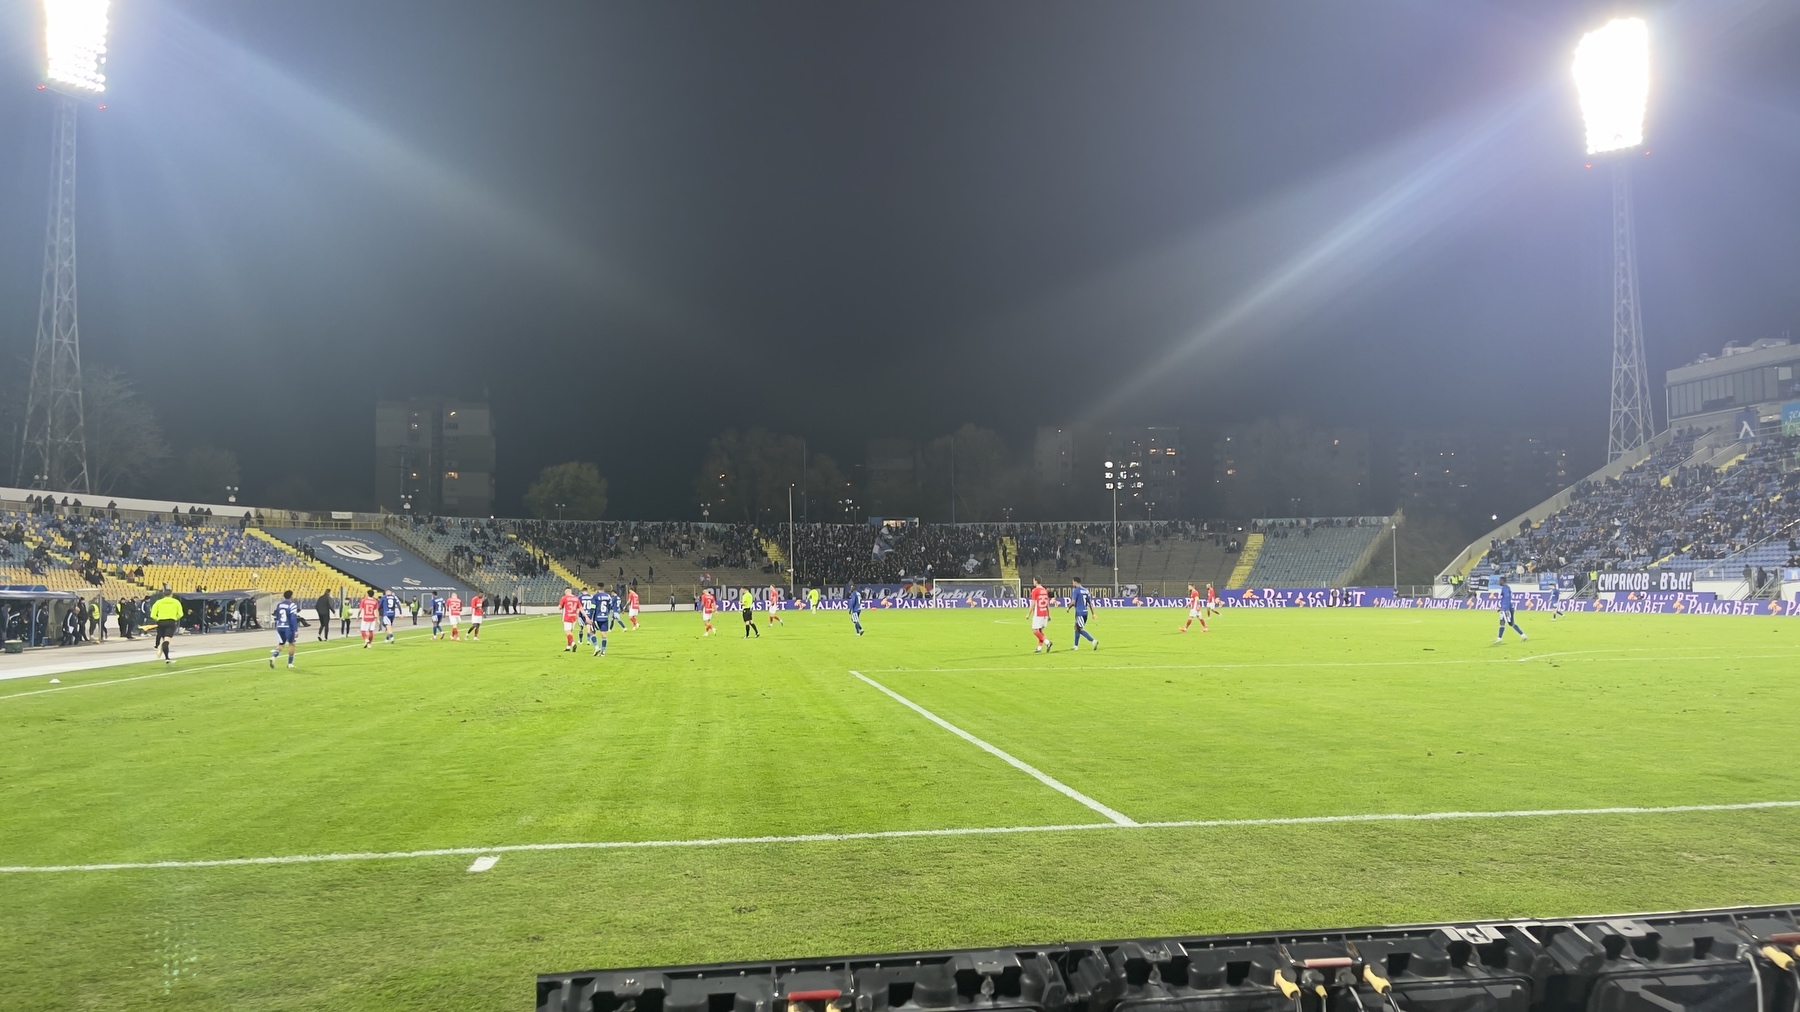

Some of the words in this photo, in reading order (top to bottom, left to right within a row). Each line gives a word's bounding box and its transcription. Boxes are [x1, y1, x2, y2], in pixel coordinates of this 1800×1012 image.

[336, 545, 371, 555] 110
[1598, 573, 1649, 591] СИРАКОВ
[1659, 572, 1692, 590] ВЪН!
[387, 599, 394, 608] 9
[600, 601, 607, 612] 6
[810, 600, 849, 611] ALMS
[895, 598, 934, 610] PALMS
[936, 598, 958, 609] BET
[980, 597, 1019, 608] PALMS
[1102, 597, 1125, 608] BET
[1146, 597, 1184, 608] PALMS
[1228, 597, 1265, 608] PALMS
[1266, 598, 1288, 608] BET
[1379, 598, 1400, 608] PALMS
[1400, 598, 1414, 608] BET
[1424, 598, 1449, 609] PALMS
[1448, 599, 1463, 610] BET
[1567, 600, 1587, 611] BET
[1605, 599, 1642, 613] PALMS
[1643, 600, 1665, 613] BET
[1687, 600, 1730, 615] PALMS
[1732, 601, 1759, 615] BET
[279, 609, 287, 622] 3
